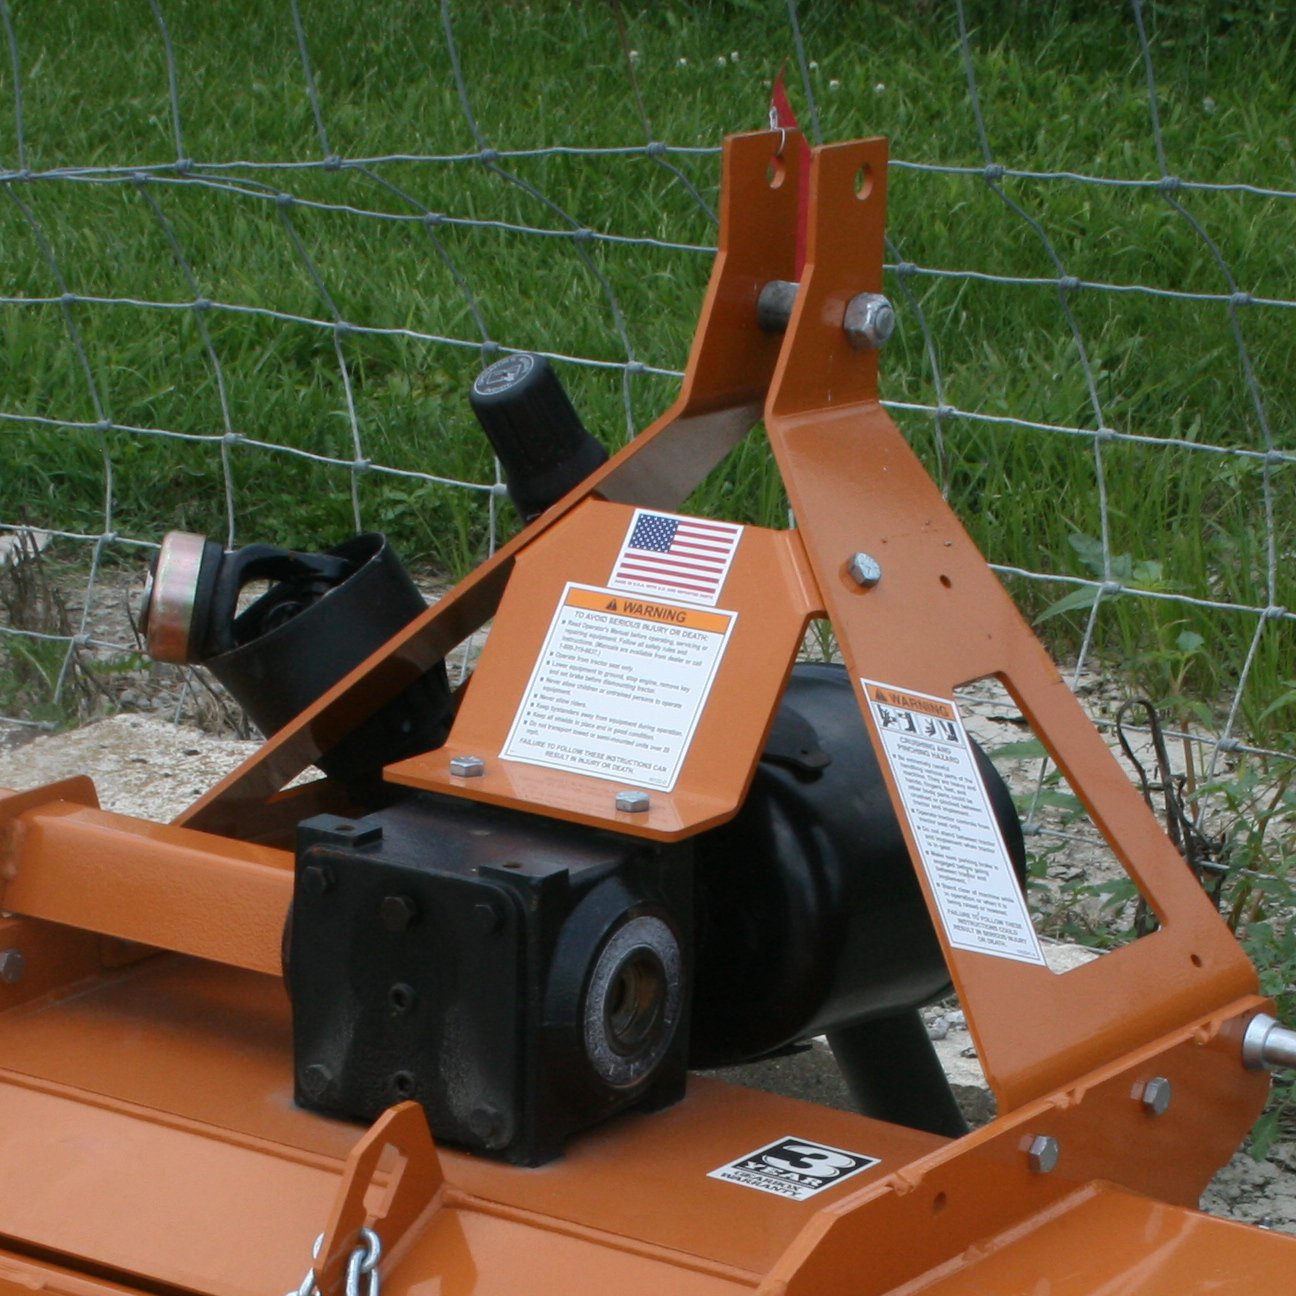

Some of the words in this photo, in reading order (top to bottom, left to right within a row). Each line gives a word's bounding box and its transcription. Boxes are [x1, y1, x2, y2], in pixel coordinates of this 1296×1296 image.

[623, 601, 687, 623] WARNING
[890, 693, 949, 717] WARNING
[762, 1144, 856, 1178] 3
[720, 1172, 803, 1198] WARRANTY
[734, 1170, 803, 1192] GEARBOX
[744, 1161, 823, 1187] YEAR
